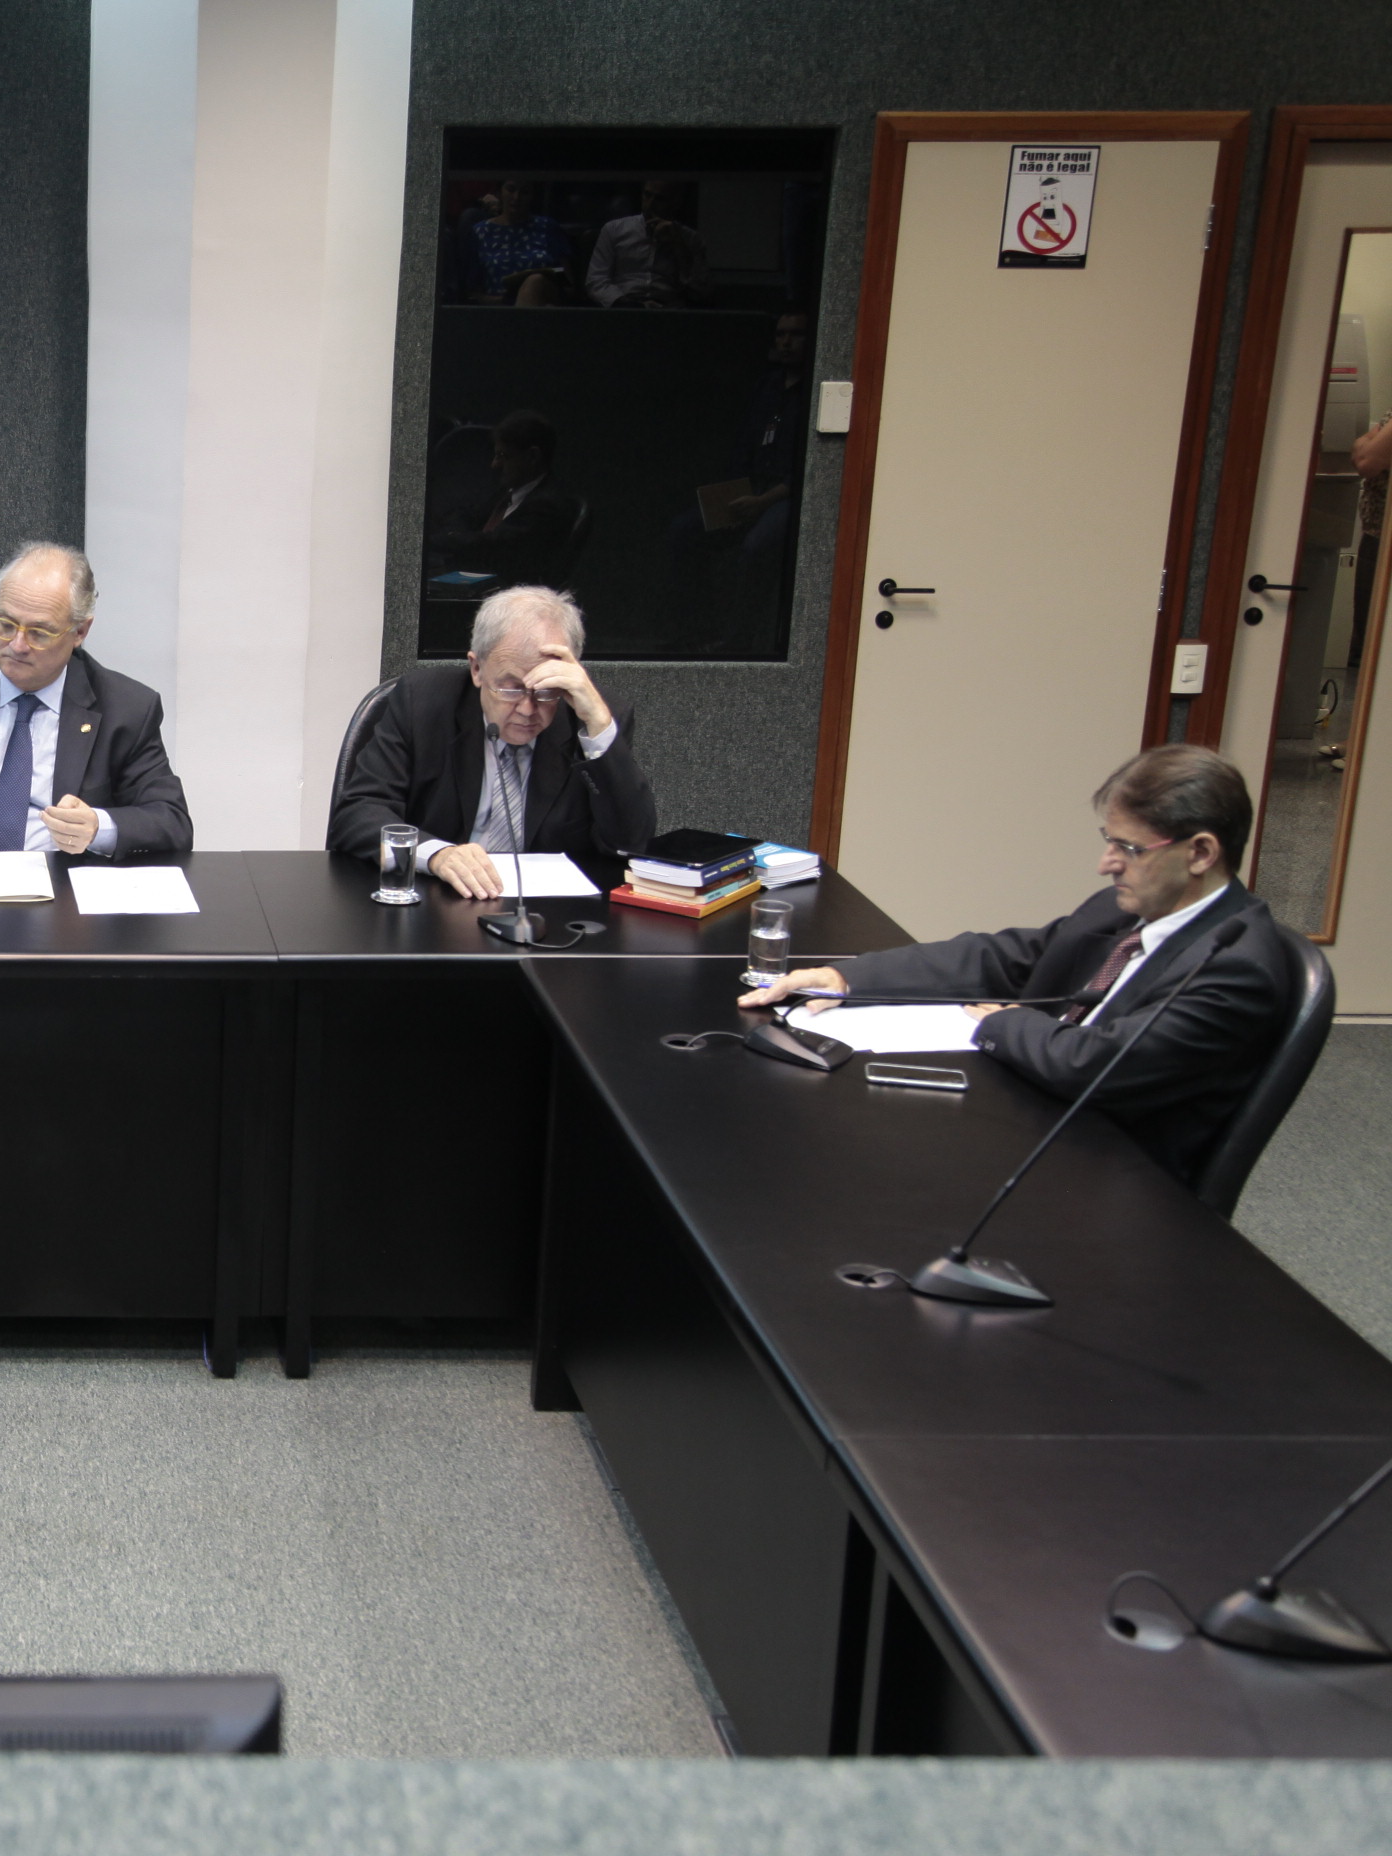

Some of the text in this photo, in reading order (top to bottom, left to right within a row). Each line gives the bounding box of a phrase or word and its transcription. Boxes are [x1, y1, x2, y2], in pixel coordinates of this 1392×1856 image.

[1021, 151, 1092, 162] Fumar aqui
[1019, 161, 1090, 173] não é legal
